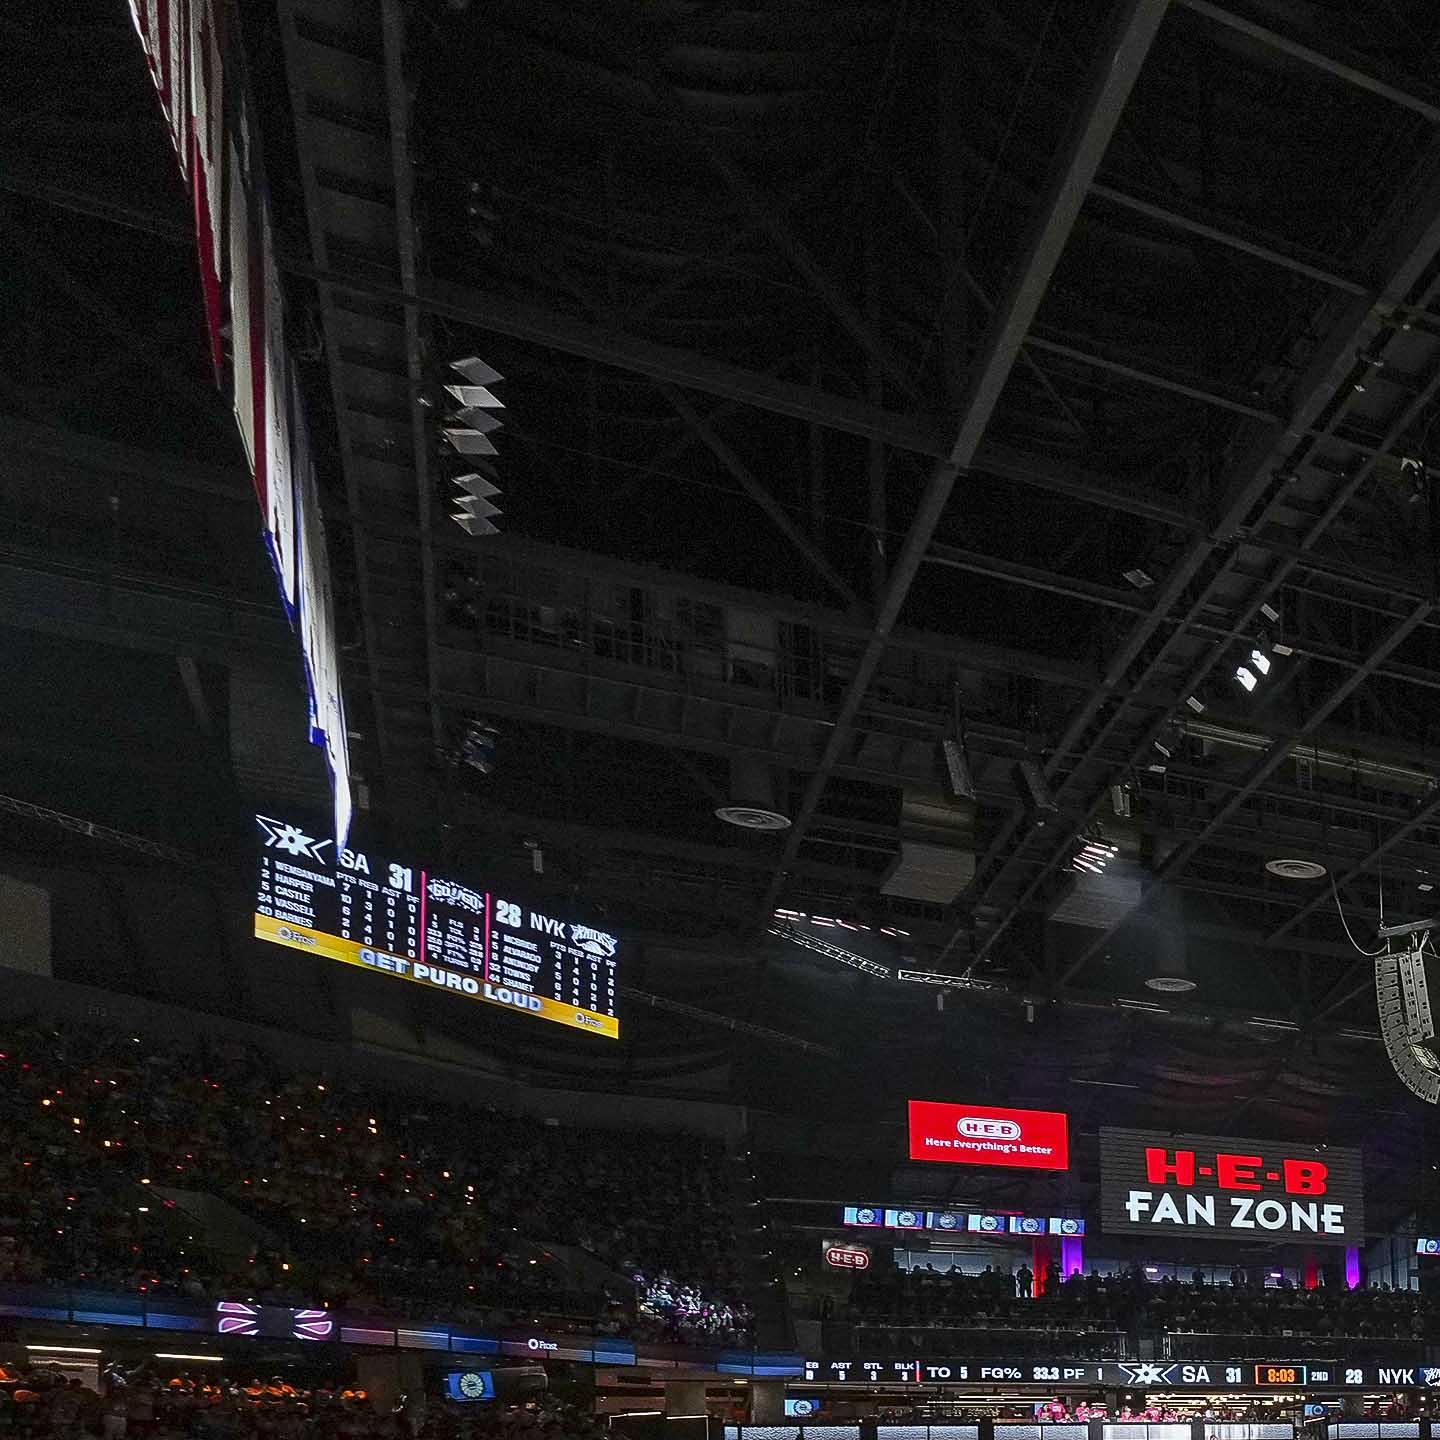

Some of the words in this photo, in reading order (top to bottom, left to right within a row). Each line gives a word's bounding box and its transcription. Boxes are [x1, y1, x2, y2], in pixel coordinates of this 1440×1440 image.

[340, 848, 370, 875] SA
[388, 863, 412, 893] 31
[275, 886, 311, 904] CASTLE
[496, 899, 521, 929] 28
[530, 912, 566, 939] NYK
[359, 948, 411, 976] GET
[413, 962, 479, 995] PURO
[483, 984, 543, 1012] LOUD
[925, 1137, 951, 1148] Here
[953, 1139, 1018, 1154] Everything's
[1019, 1144, 1053, 1155] Better
[1145, 1147, 1329, 1195] H-E-B
[1125, 1190, 1216, 1226] FAN
[1230, 1197, 1345, 1234] ZONE
[540, 1341, 559, 1350] Frost
[830, 1362, 852, 1370] AST
[863, 1362, 883, 1370] STL
[895, 1362, 914, 1370] BLK
[927, 1367, 951, 1378] TO
[981, 1367, 1022, 1379] FG%
[1033, 1367, 1060, 1380] 33.3
[1064, 1369, 1085, 1379] PF
[1182, 1365, 1210, 1383] SA
[1226, 1367, 1242, 1383] 31
[1268, 1368, 1295, 1383] 8:03
[1311, 1372, 1329, 1382] 2ND
[1345, 1369, 1363, 1384] 28
[1379, 1368, 1415, 1384] NYK
